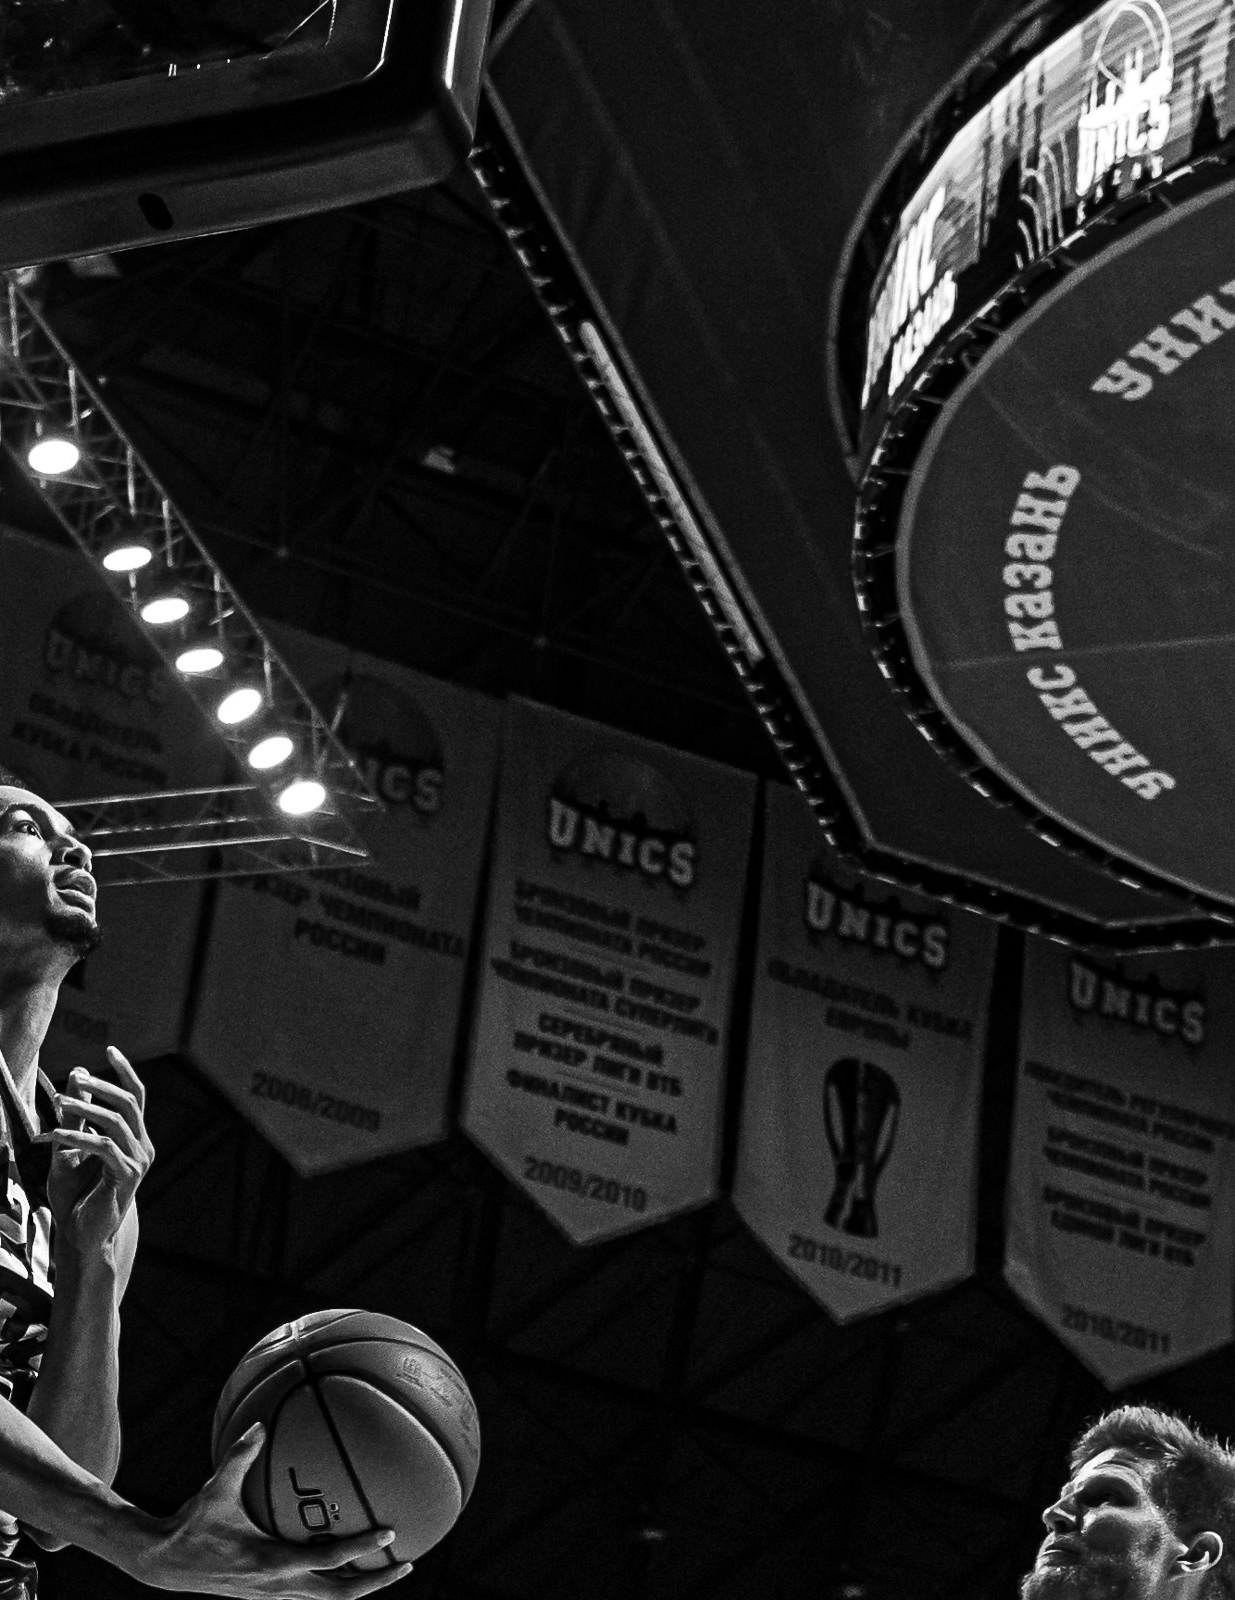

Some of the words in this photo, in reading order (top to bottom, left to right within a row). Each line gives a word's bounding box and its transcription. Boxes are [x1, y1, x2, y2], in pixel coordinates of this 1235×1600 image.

[1090, 278, 1235, 401] УНИ
[548, 796, 696, 889] UNICS
[804, 881, 949, 969] UNICS
[1068, 958, 1207, 1046] UNICS
